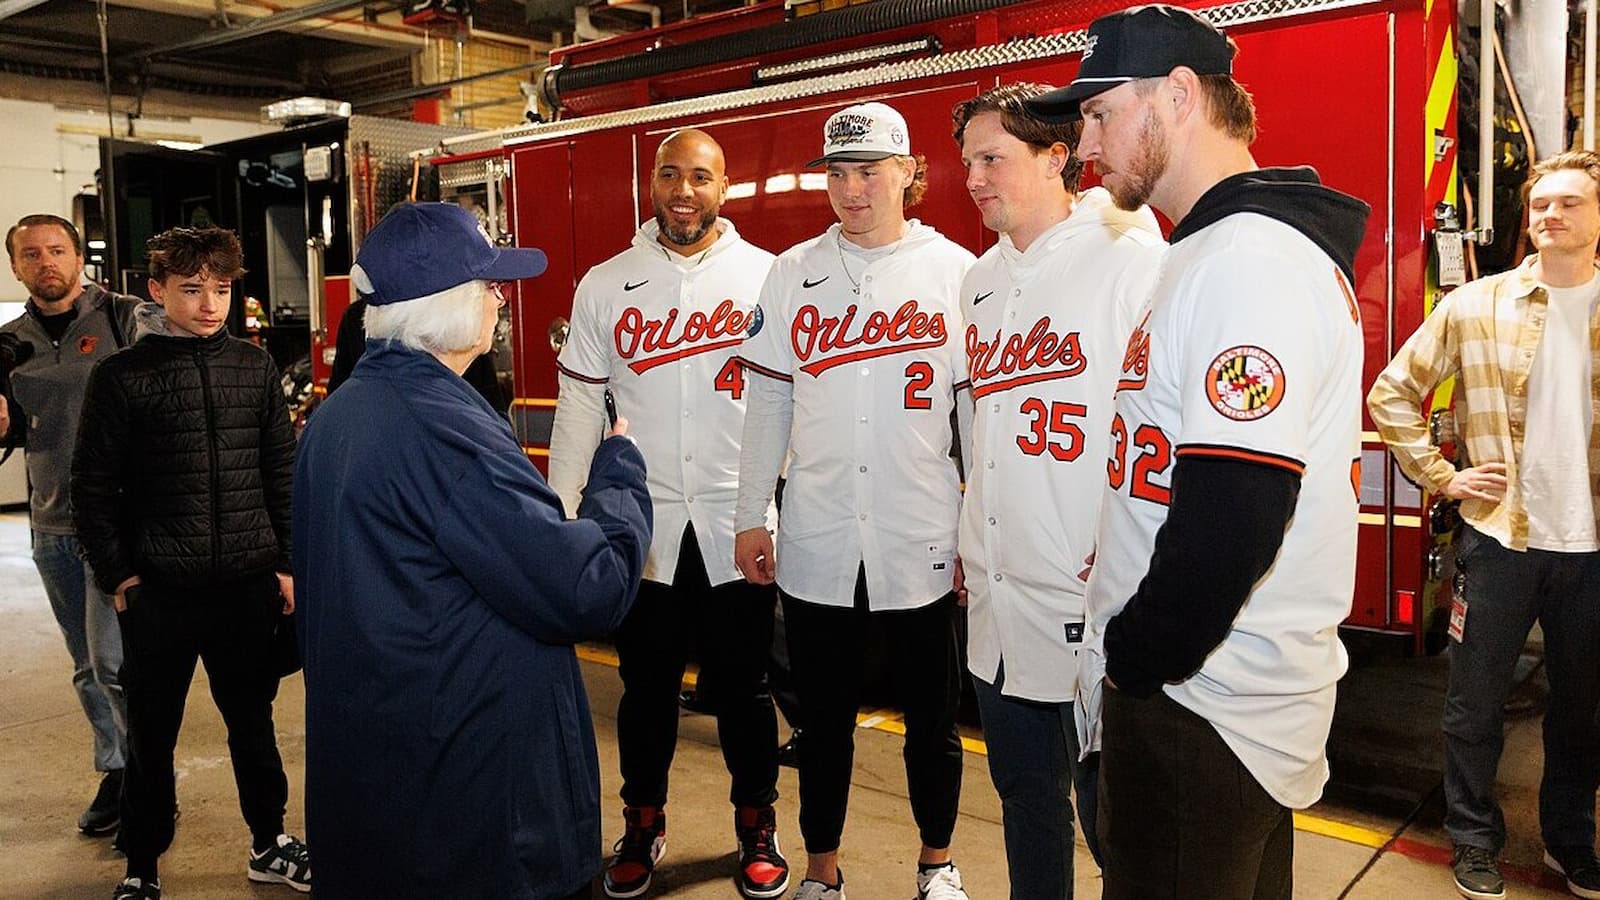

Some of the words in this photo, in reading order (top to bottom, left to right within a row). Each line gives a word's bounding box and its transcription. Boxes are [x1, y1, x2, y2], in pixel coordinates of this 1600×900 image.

[614, 299, 752, 359] Oriole
[792, 299, 946, 361] Orioles
[903, 361, 934, 410] 2
[1213, 347, 1281, 375] BALTIMORE
[1016, 397, 1088, 463] 35
[1215, 400, 1271, 419] ORIOLES
[1107, 412, 1171, 506] 32
